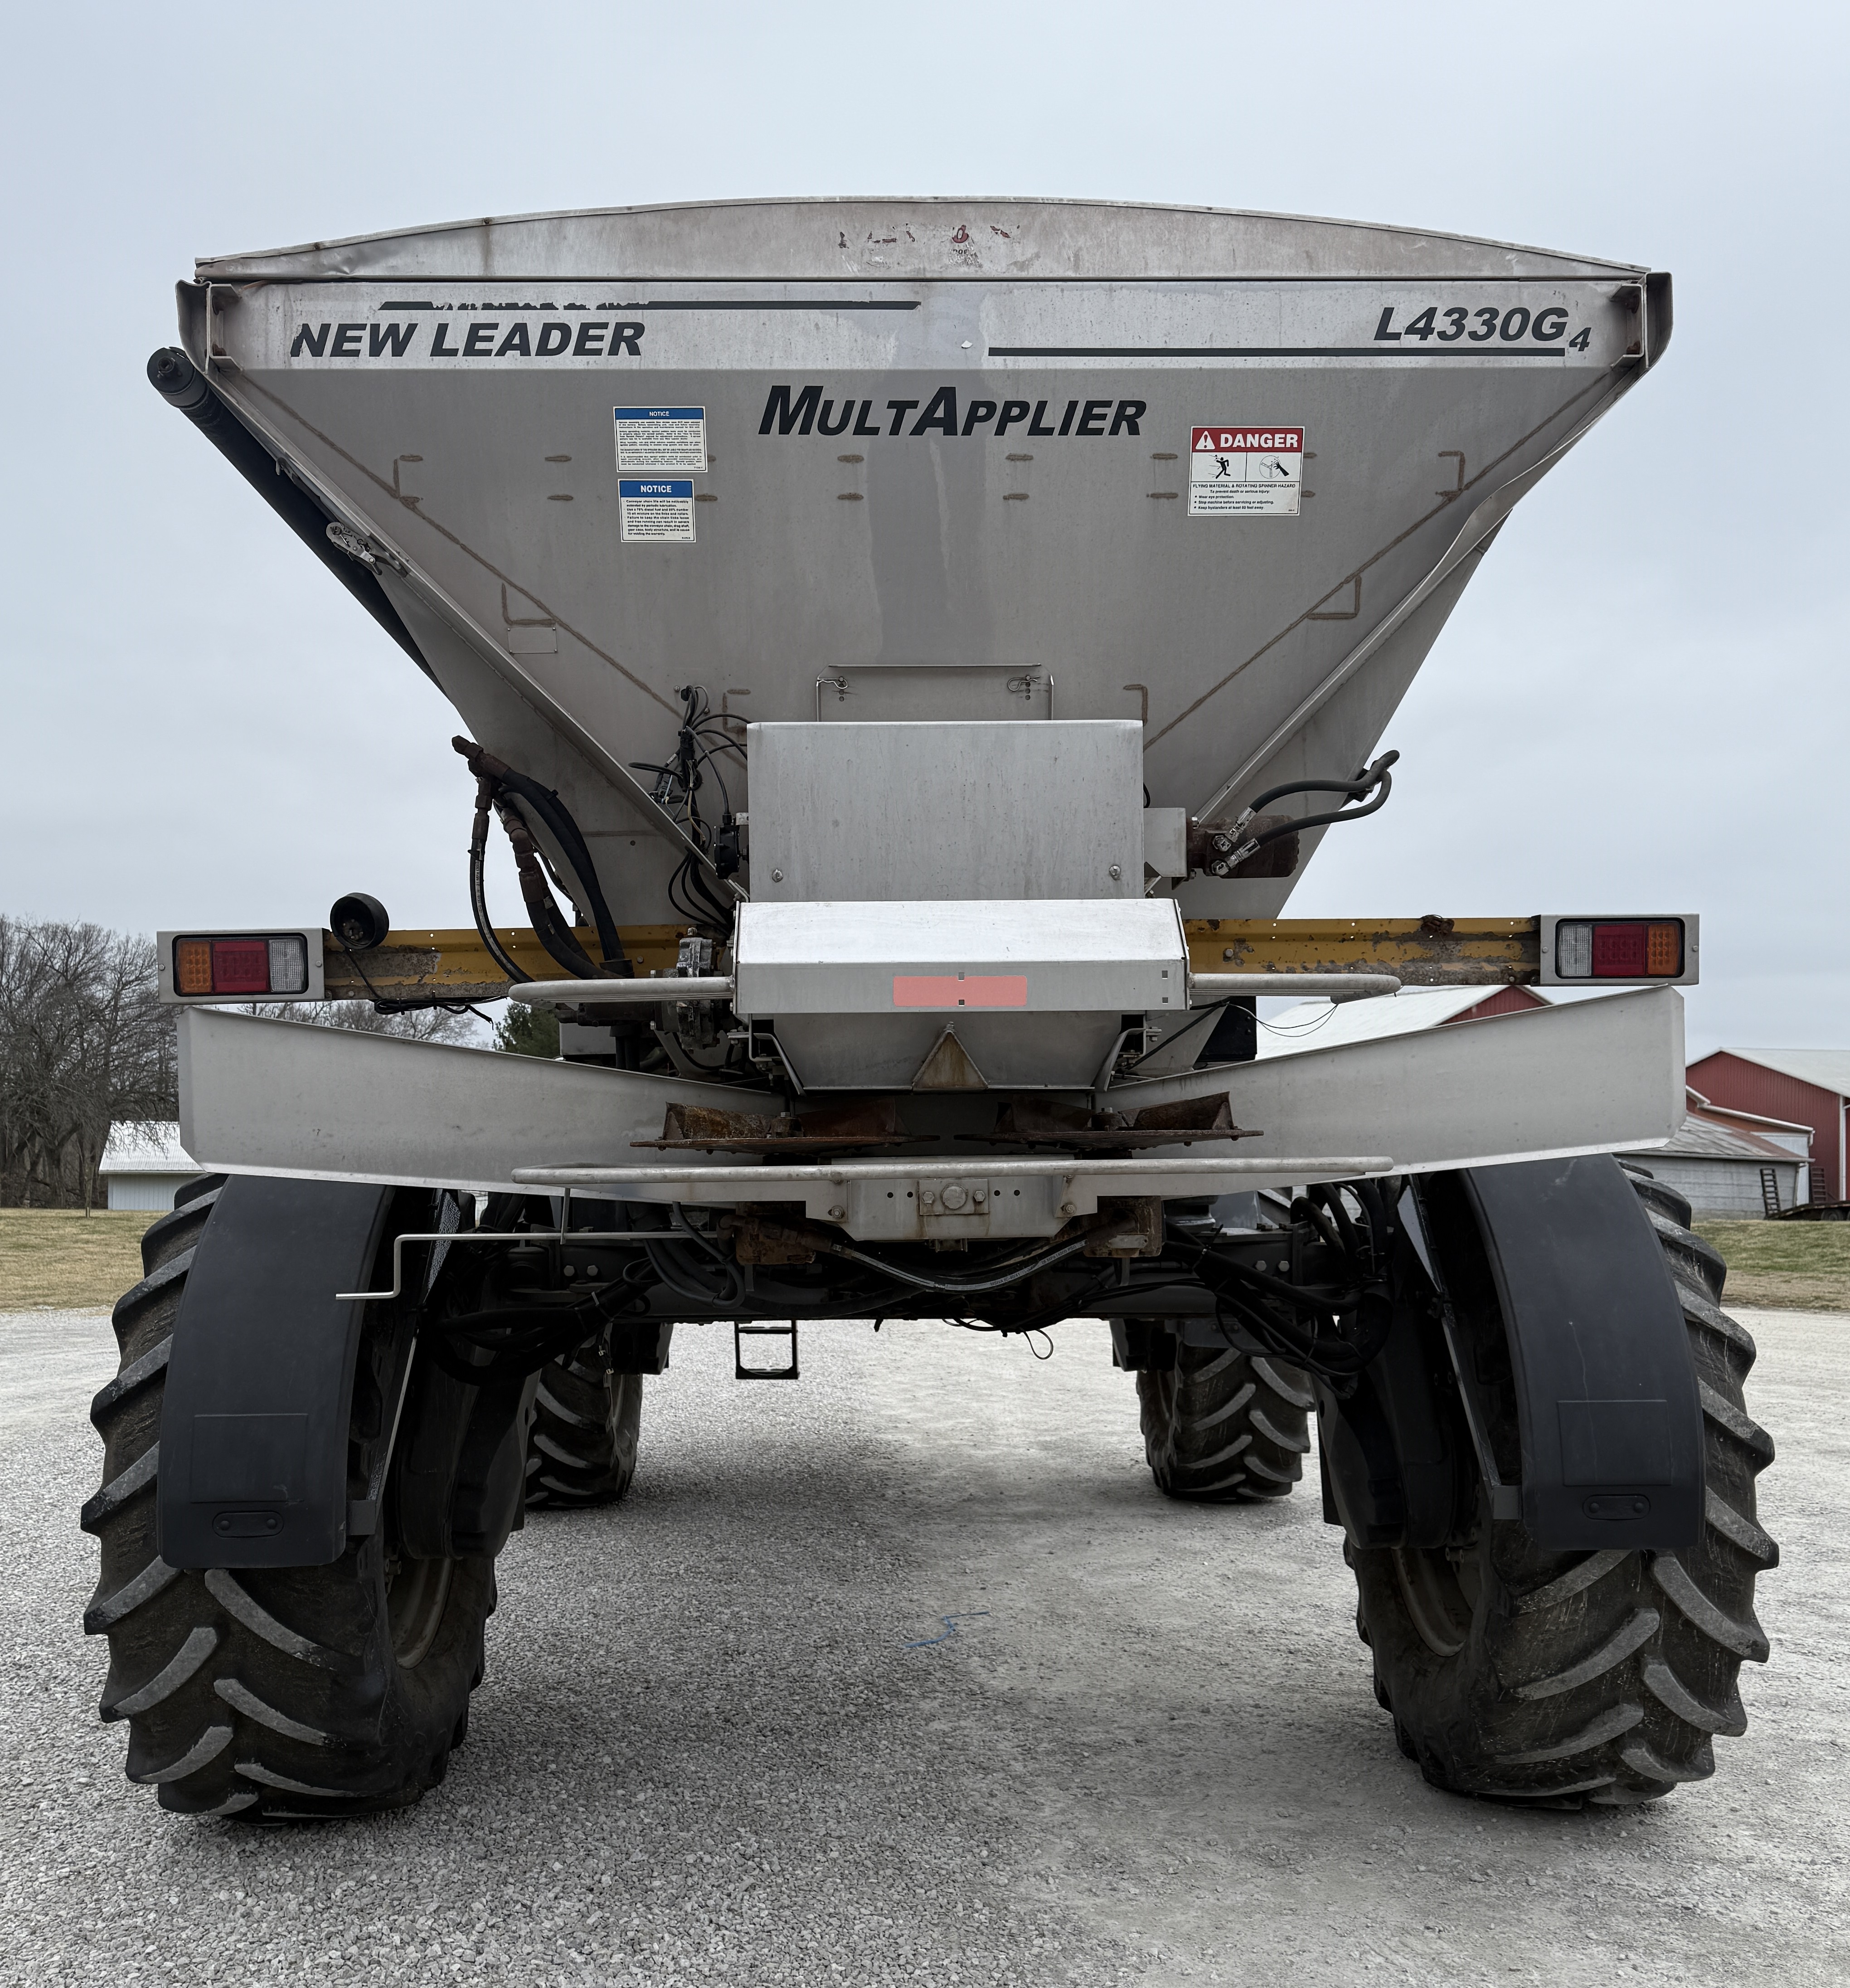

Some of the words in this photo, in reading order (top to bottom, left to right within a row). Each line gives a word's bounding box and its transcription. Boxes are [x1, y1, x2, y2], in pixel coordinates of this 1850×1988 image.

[290, 322, 418, 357] NEW
[429, 321, 646, 357] LEADER
[1220, 433, 1298, 448] DANGER
